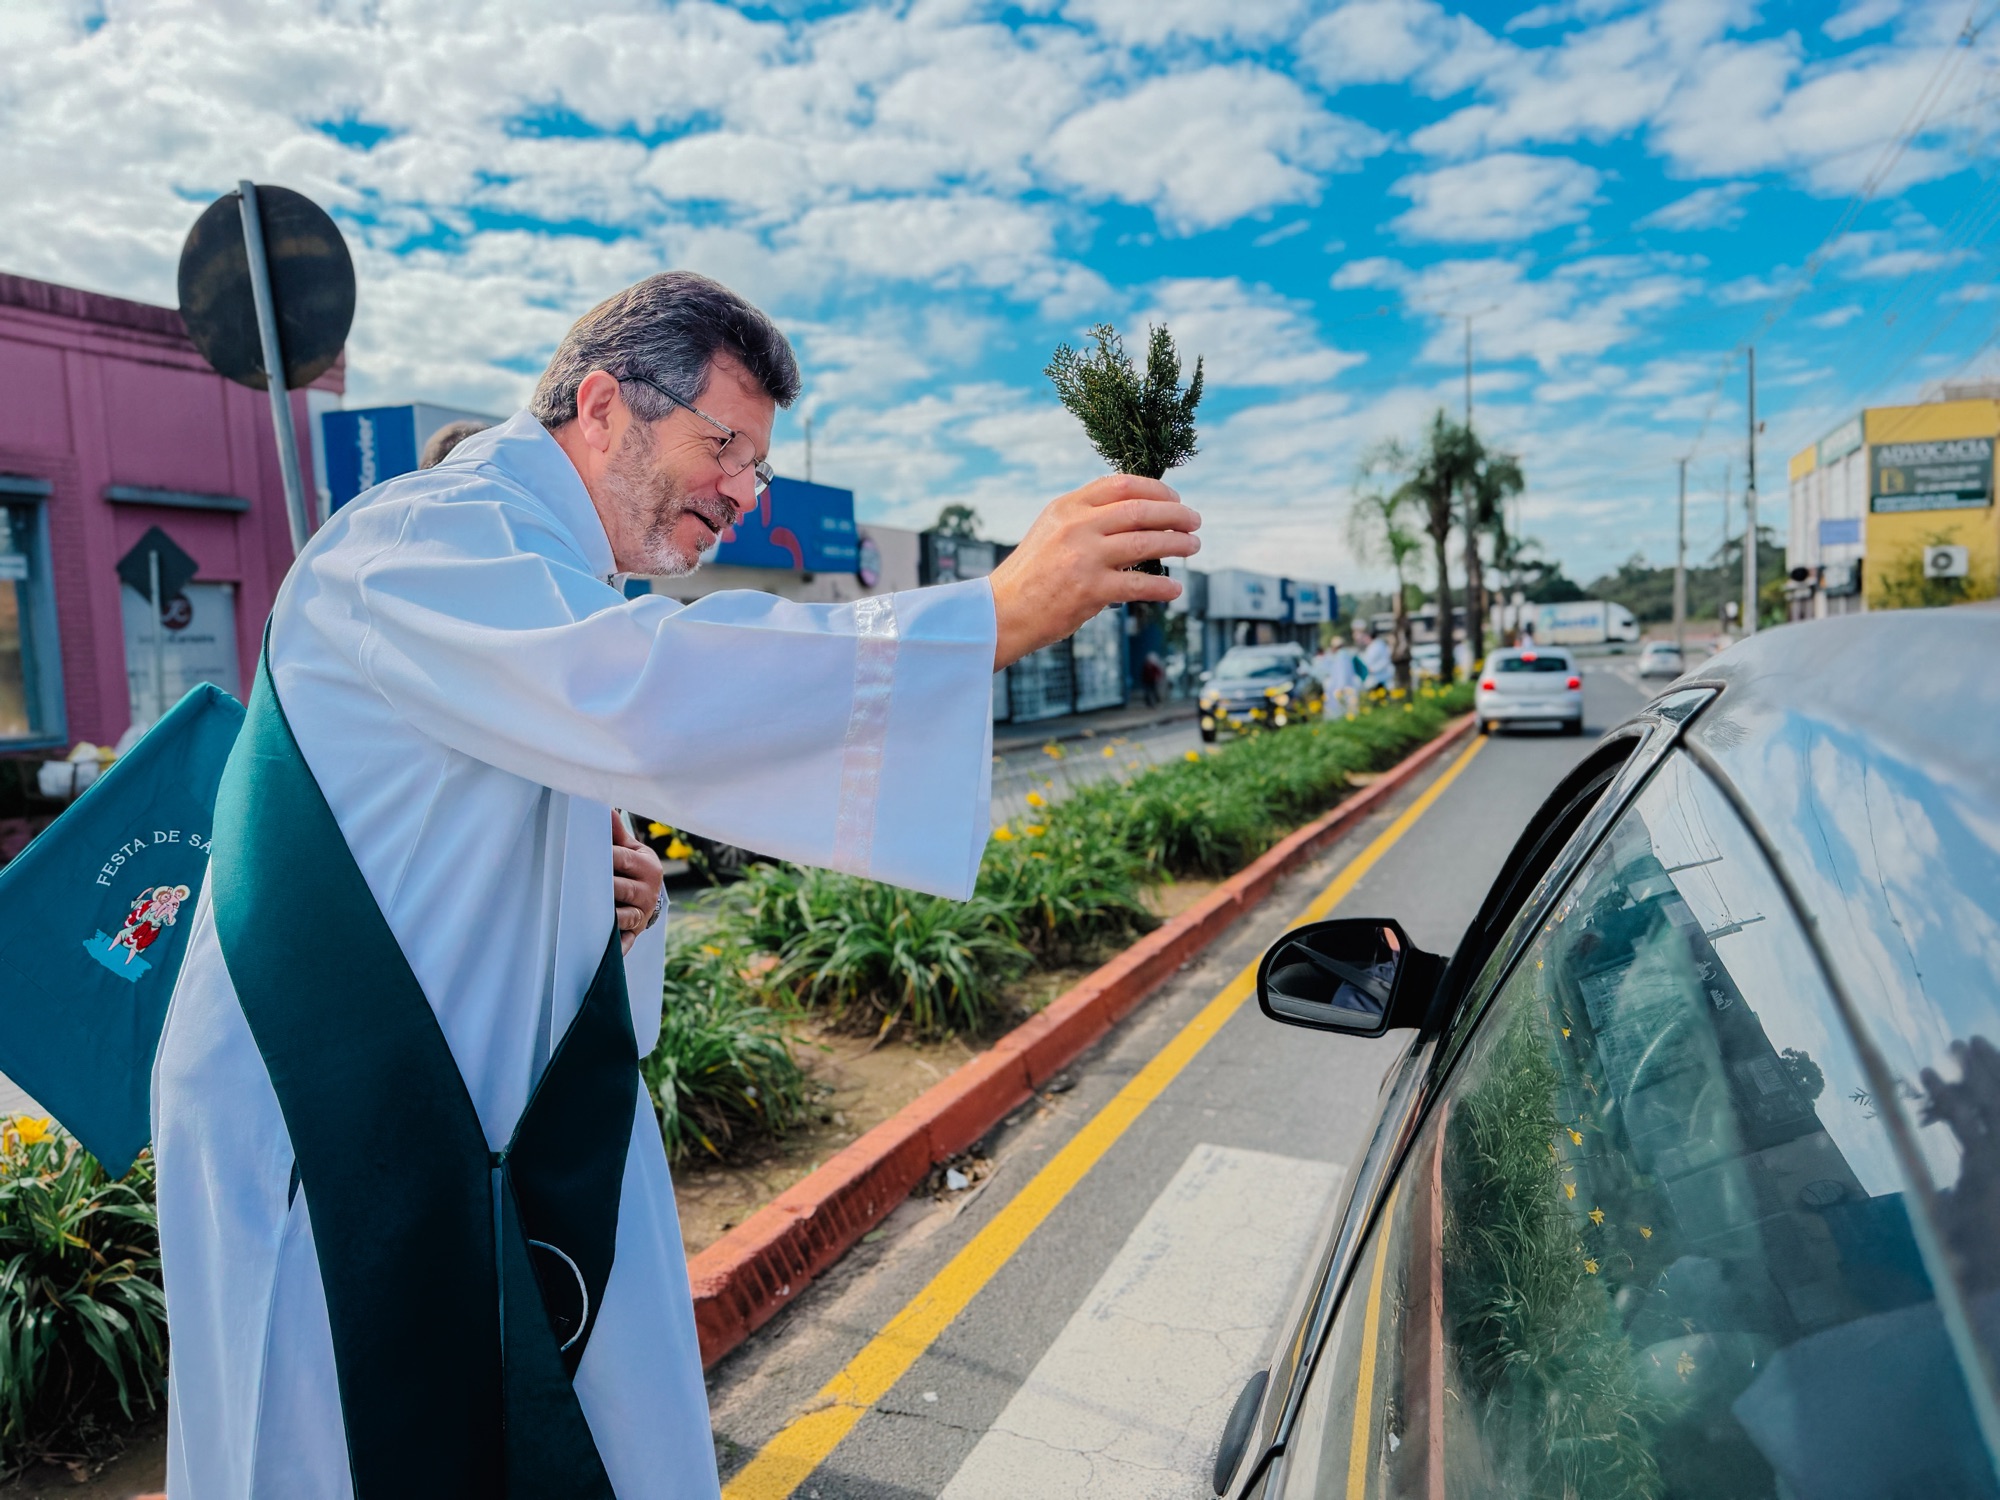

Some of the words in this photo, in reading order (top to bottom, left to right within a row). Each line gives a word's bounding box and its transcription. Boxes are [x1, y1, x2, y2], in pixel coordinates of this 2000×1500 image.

[1878, 439, 1990, 465] ADVOCACIA
[96, 838, 149, 887] FESTA
[153, 830, 181, 844] DE
